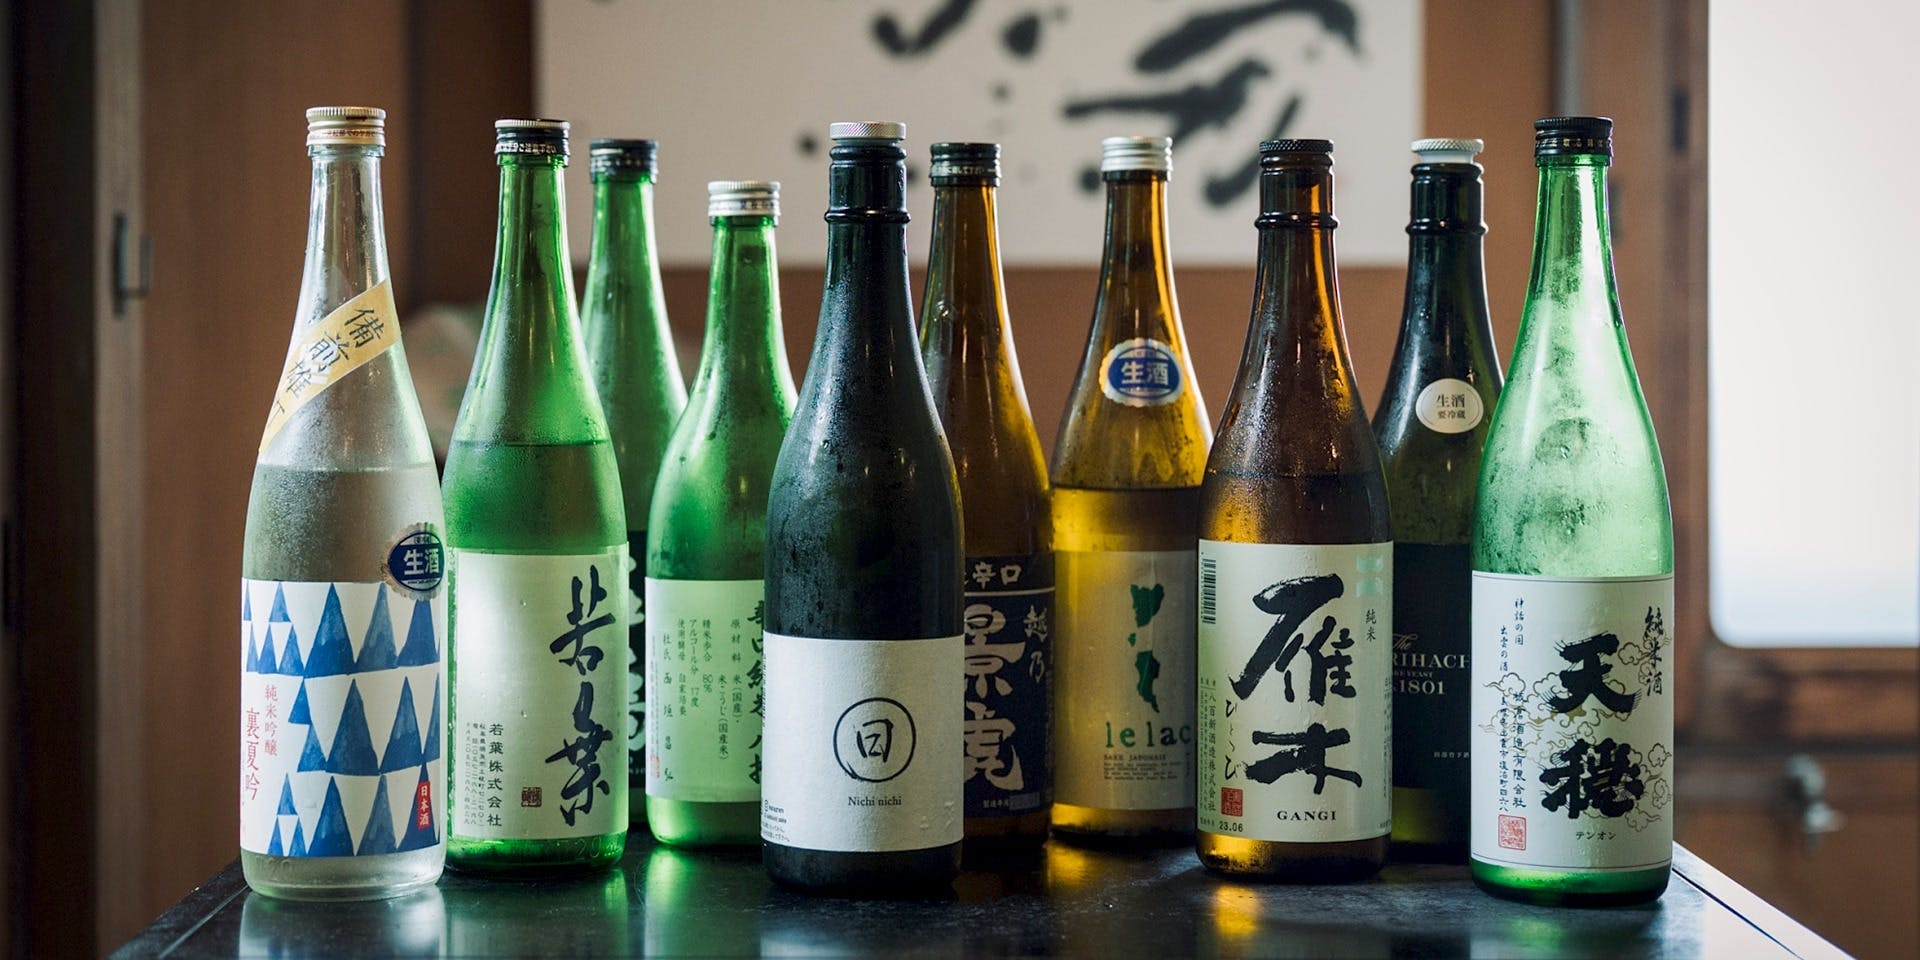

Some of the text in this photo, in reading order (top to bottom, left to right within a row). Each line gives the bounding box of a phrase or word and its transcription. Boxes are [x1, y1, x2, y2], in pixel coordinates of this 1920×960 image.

[1121, 361, 1169, 386] 生酒
[1437, 394, 1465, 408] 生酒
[404, 548, 440, 576] 生酒
[965, 561, 1022, 589] 辛口
[1364, 608, 1377, 642] 純米
[1645, 606, 1665, 697] 純米酒
[1228, 573, 1363, 795] 雁木
[1394, 679, 1445, 695] 1801
[264, 684, 279, 757] 純米吟醸
[1105, 721, 1191, 749] le lac
[487, 723, 504, 827] 若葉株式会社
[420, 785, 430, 825] 日本酒
[848, 796, 902, 807] Nichi nichi
[1276, 810, 1337, 821] GANGI
[1218, 821, 1244, 833] 23.06
[1575, 832, 1617, 841] テンオン
